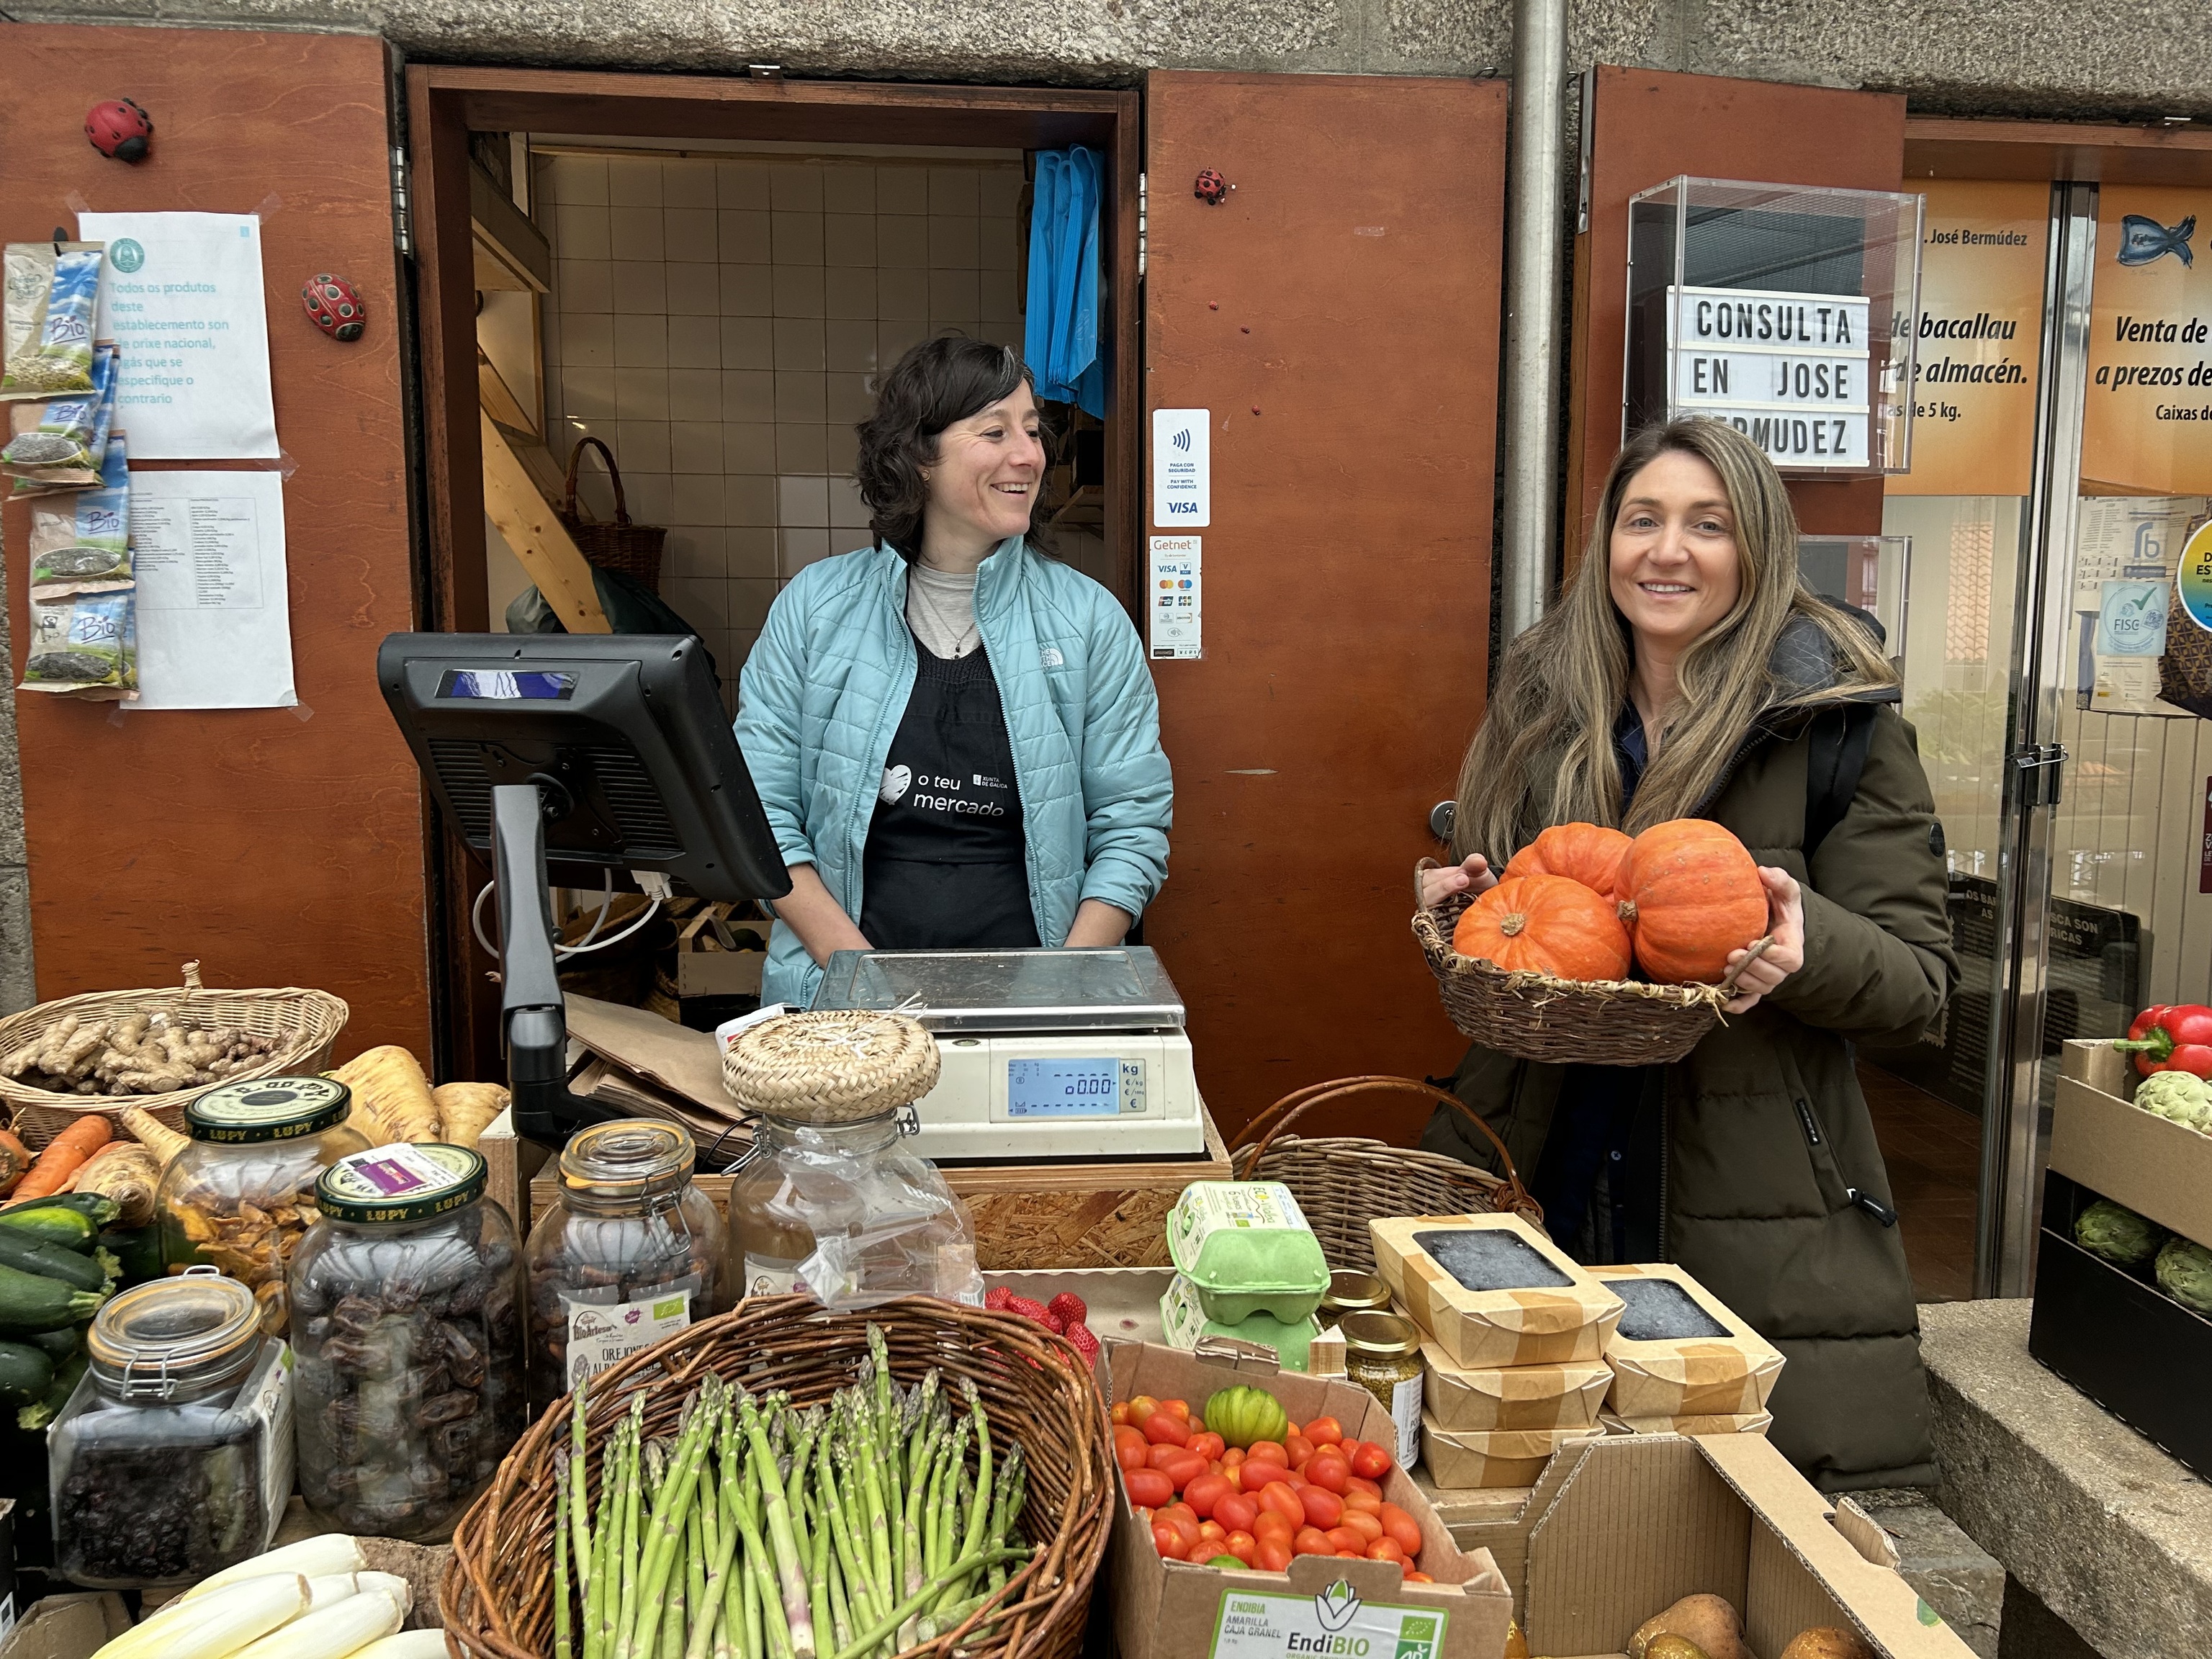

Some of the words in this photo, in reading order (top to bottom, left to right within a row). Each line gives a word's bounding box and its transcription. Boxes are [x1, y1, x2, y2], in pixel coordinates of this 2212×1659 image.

[1930, 228, 1959, 244] José
[1962, 230, 2028, 246] Bermúdez
[109, 282, 145, 293] Todos
[148, 284, 160, 293] os
[163, 282, 217, 295] produtos
[111, 302, 144, 312] deste
[50, 315, 85, 343] Bio
[113, 319, 205, 331] establecemento
[208, 321, 229, 331] son
[1697, 300, 1851, 344] CONSULTA
[1919, 312, 2017, 340] bacallau
[2116, 316, 2178, 343] Venta
[2181, 318, 2208, 343] de
[132, 338, 161, 349] orixe
[164, 337, 216, 350] nacional,
[145, 359, 166, 369] que
[170, 359, 183, 367] se
[1925, 356, 2028, 384] almacén.
[118, 374, 184, 387] especifique
[186, 377, 194, 385] o
[1694, 357, 1729, 394] EN
[1777, 361, 1848, 399] JOSE
[2095, 365, 2110, 385] a
[2111, 366, 2185, 392] prezos
[2188, 361, 2212, 387] de
[117, 393, 173, 404] contrario
[1928, 402, 1937, 418] 5
[1940, 401, 1961, 422] kg.
[2156, 405, 2198, 421] Caixas
[1166, 502, 1198, 513] VISA
[86, 511, 120, 531] Bio
[1154, 540, 1192, 550] Getnet
[78, 615, 116, 640] Bio
[918, 775, 930, 786] o
[934, 775, 961, 791] teu
[913, 793, 1004, 817] mercado
[2074, 918, 2099, 935] SON
[2050, 927, 2083, 946] RICAS
[1123, 1063, 1138, 1076] kg
[1130, 1098, 1137, 1109] €
[209, 1129, 247, 1141] LUPY
[274, 1121, 314, 1138] LUPY
[366, 1208, 409, 1222] LUPY
[435, 1190, 469, 1213] LUPY
[1231, 1600, 1266, 1615] ENDIBIA
[1226, 1614, 1269, 1627] AMARILLA
[1224, 1624, 1245, 1635] CAJA
[1248, 1626, 1282, 1639] GRANEL
[1287, 1632, 1370, 1658] EndiBIO
